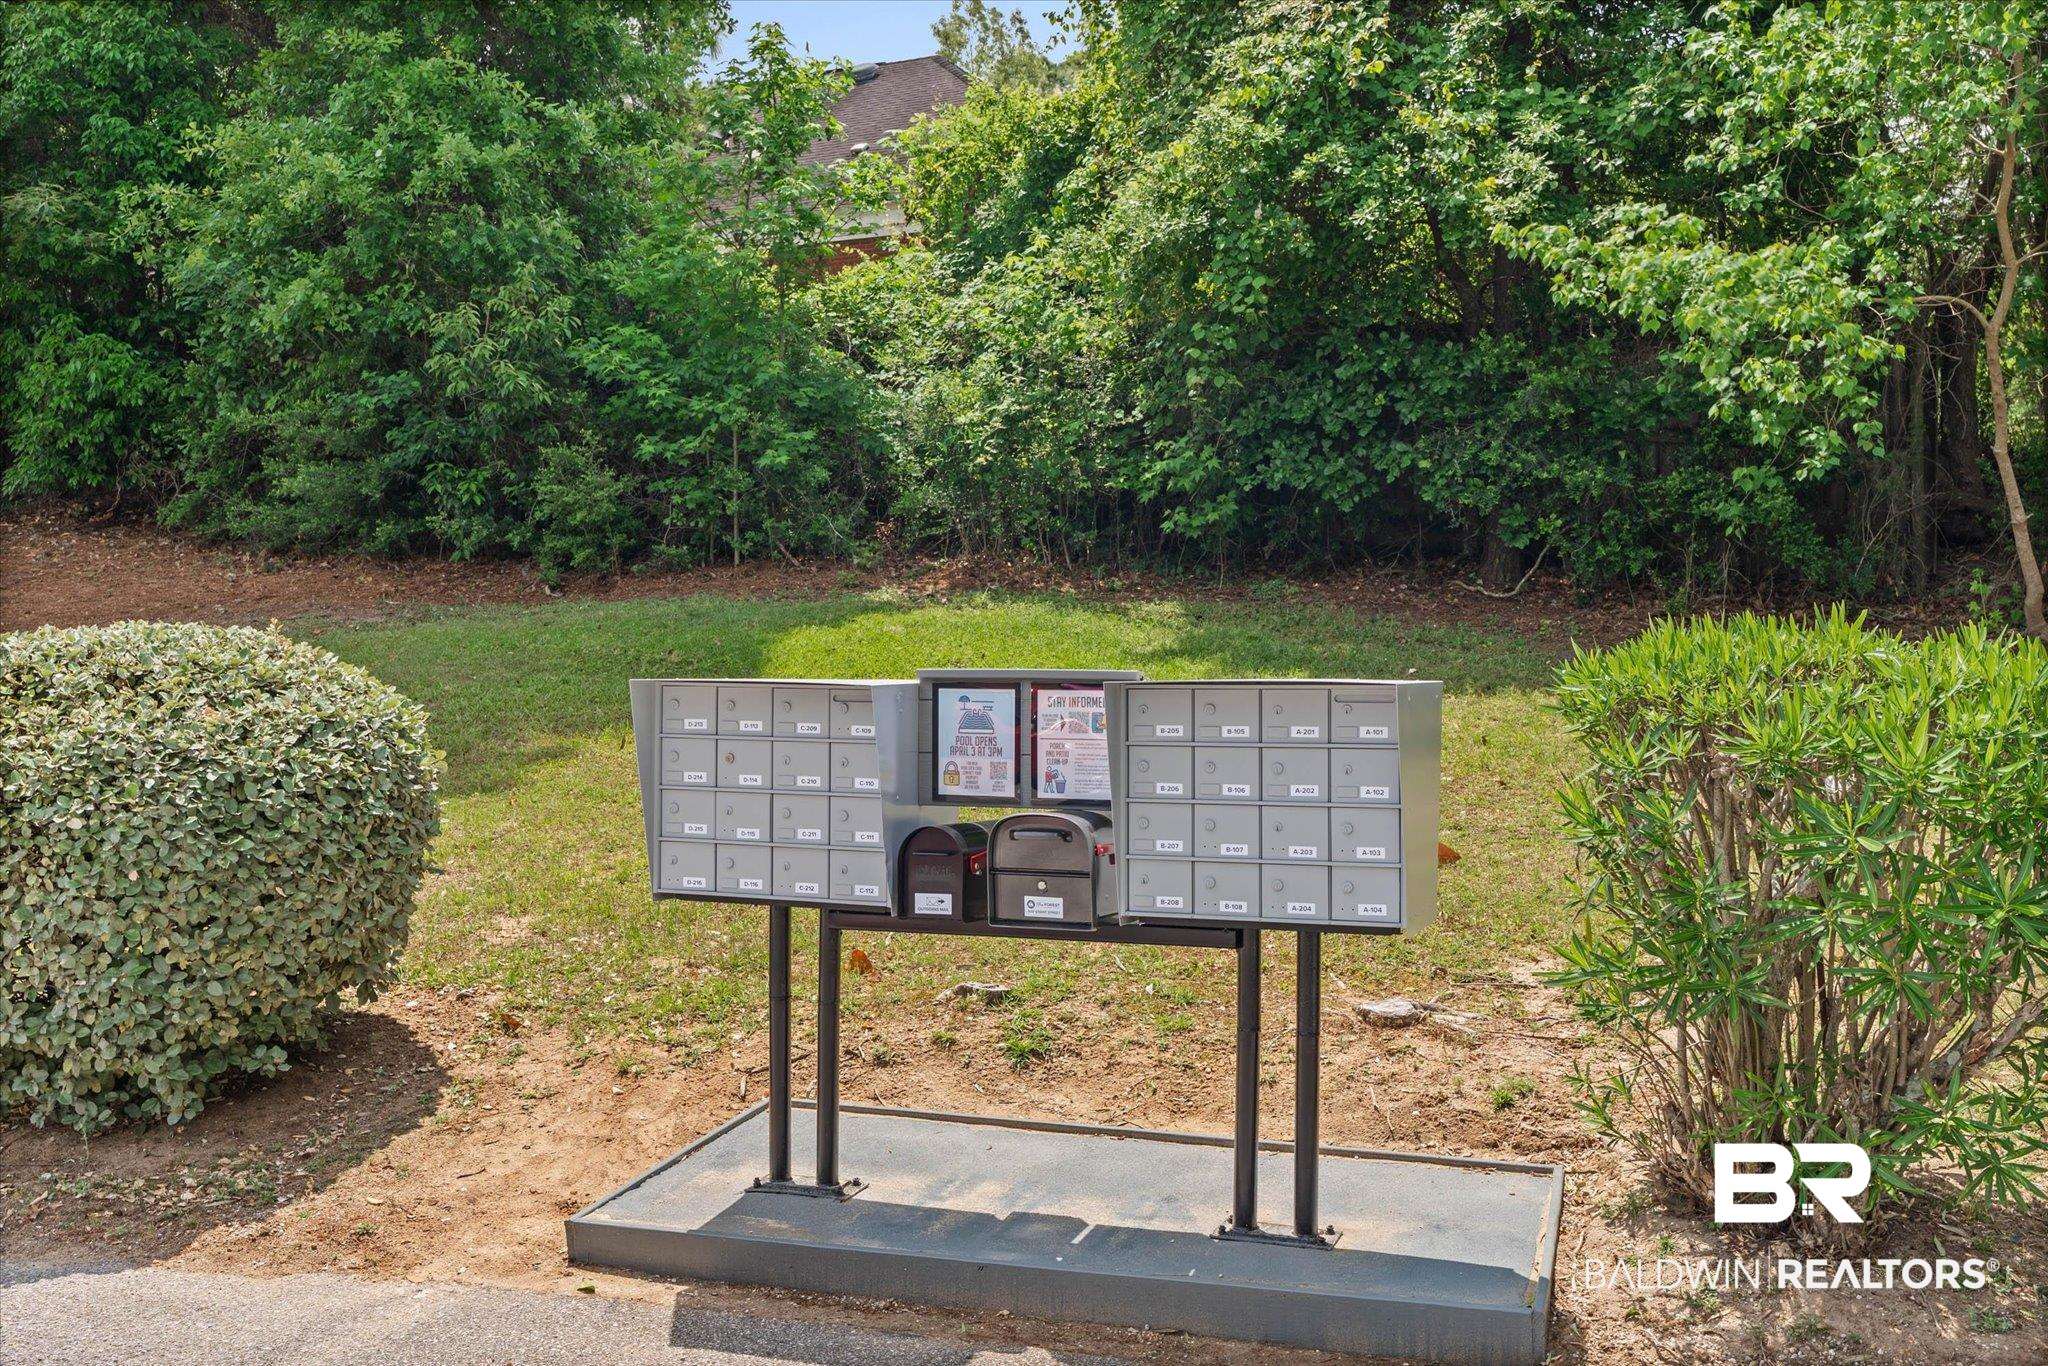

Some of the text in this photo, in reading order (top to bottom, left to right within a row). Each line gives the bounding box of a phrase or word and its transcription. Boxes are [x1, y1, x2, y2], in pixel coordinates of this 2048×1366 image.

[1048, 696, 1066, 708] STAY
[955, 736, 998, 746] POOL OPENS
[950, 746, 1002, 757] APRIL 3 AT 3PM
